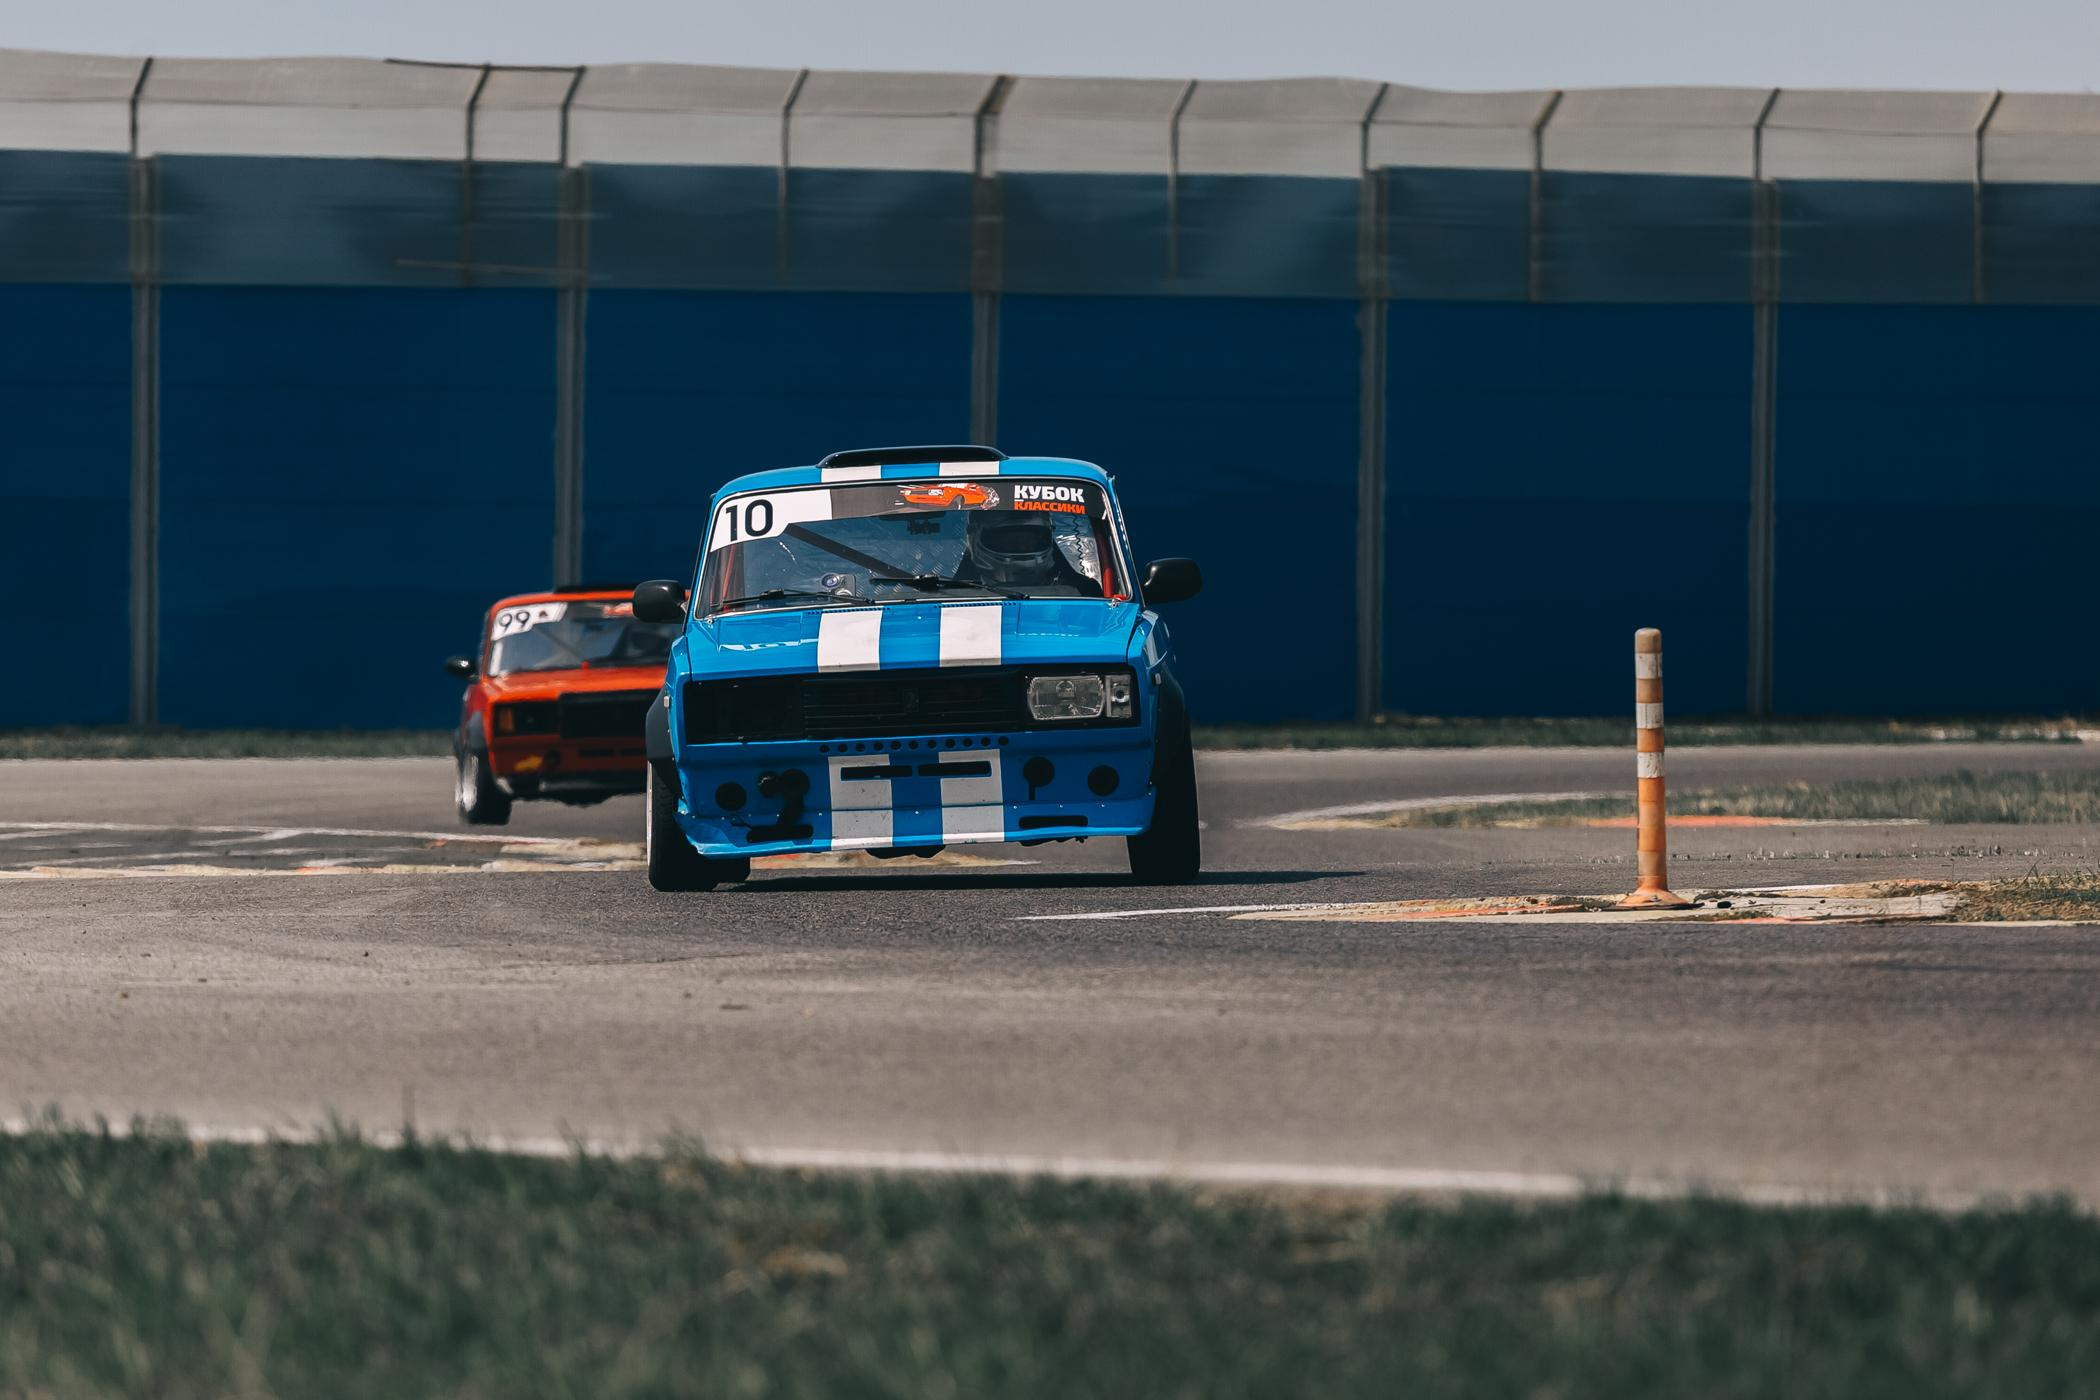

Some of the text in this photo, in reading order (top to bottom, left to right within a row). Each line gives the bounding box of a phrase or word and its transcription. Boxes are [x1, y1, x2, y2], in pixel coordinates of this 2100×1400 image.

[1014, 485, 1085, 503] КУБОК
[1014, 500, 1085, 514] КЛАССИКИ
[726, 499, 773, 542] 10
[499, 611, 530, 632] 99
